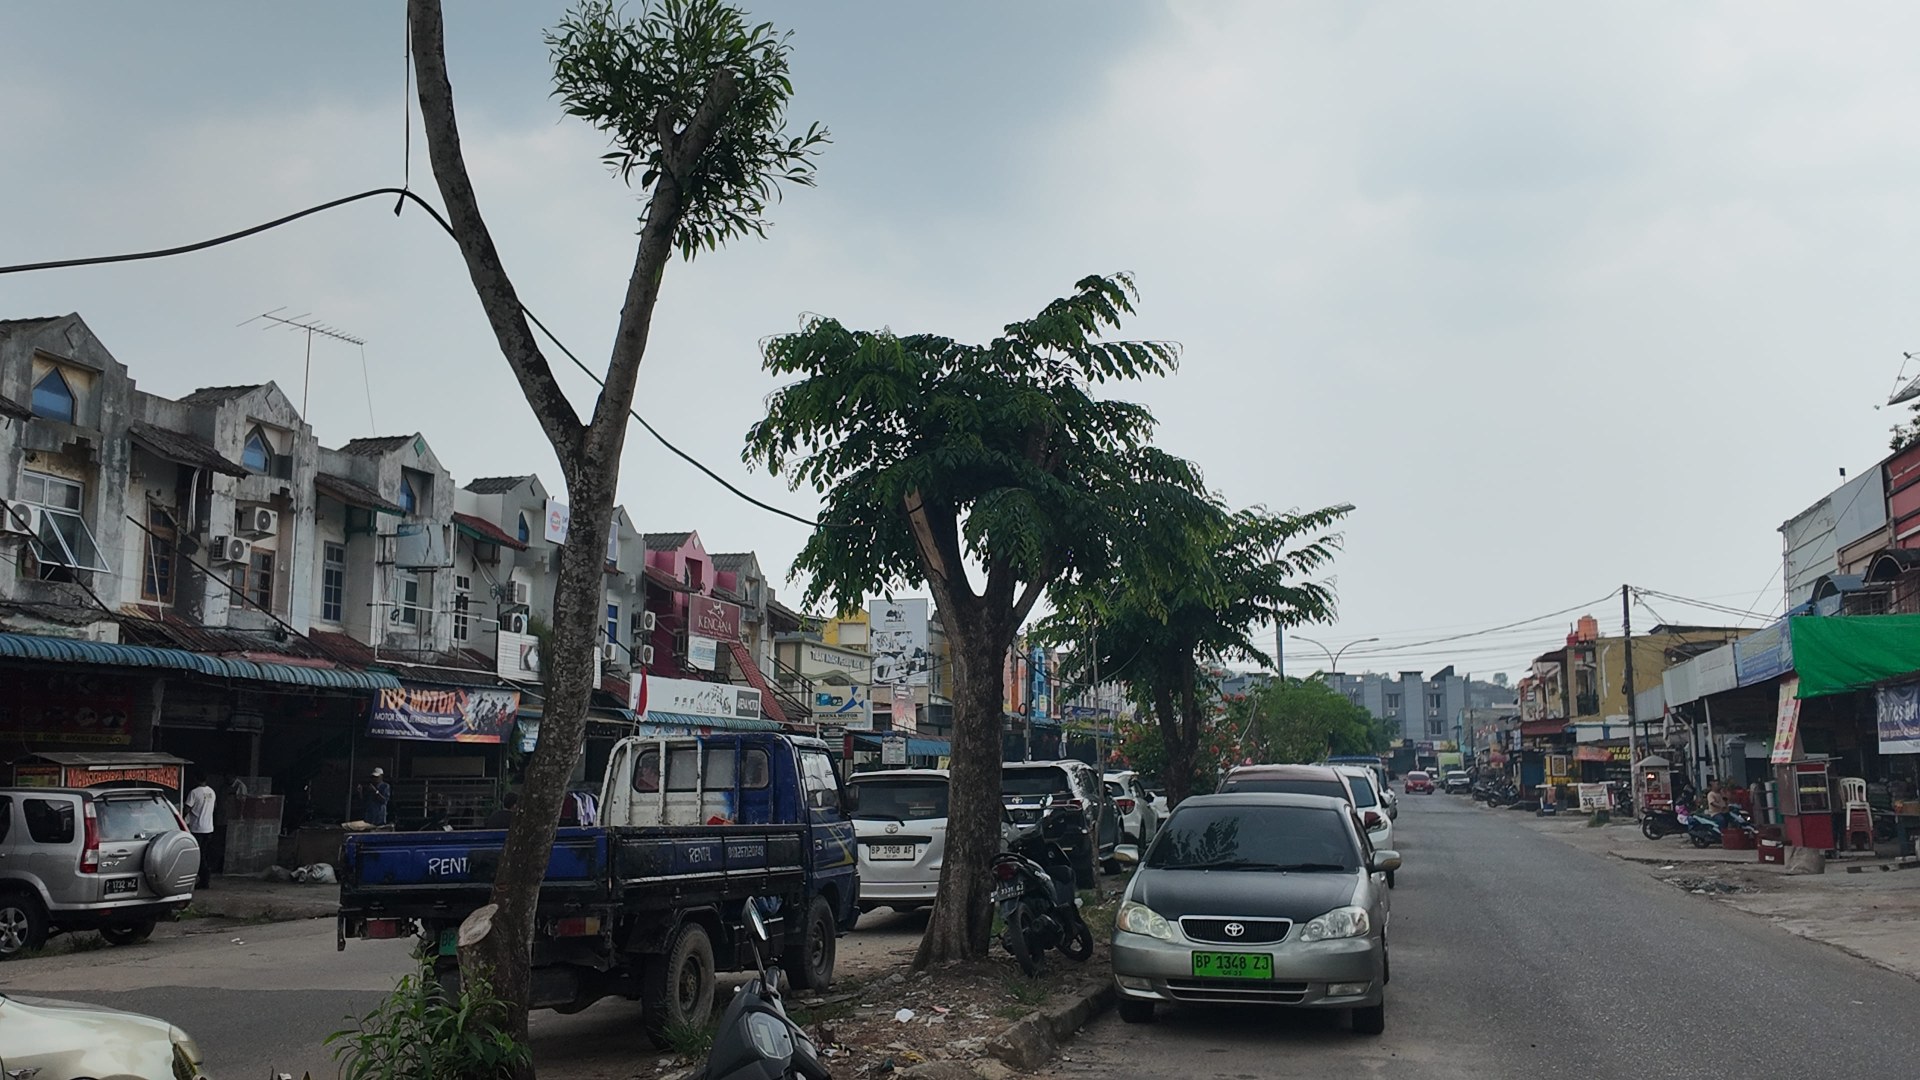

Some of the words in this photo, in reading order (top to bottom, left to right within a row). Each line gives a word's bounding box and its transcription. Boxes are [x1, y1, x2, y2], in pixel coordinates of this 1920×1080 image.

[698, 615, 733, 634] KENCANA
[409, 688, 456, 714] MOTOR
[871, 845, 880, 854] BP
[904, 845, 912, 854] AF
[428, 857, 473, 875] RENT
[441, 931, 455, 947] BP
[1195, 955, 1211, 969] BP
[1215, 956, 1247, 970] 1348
[1253, 956, 1269, 970] ZJ
